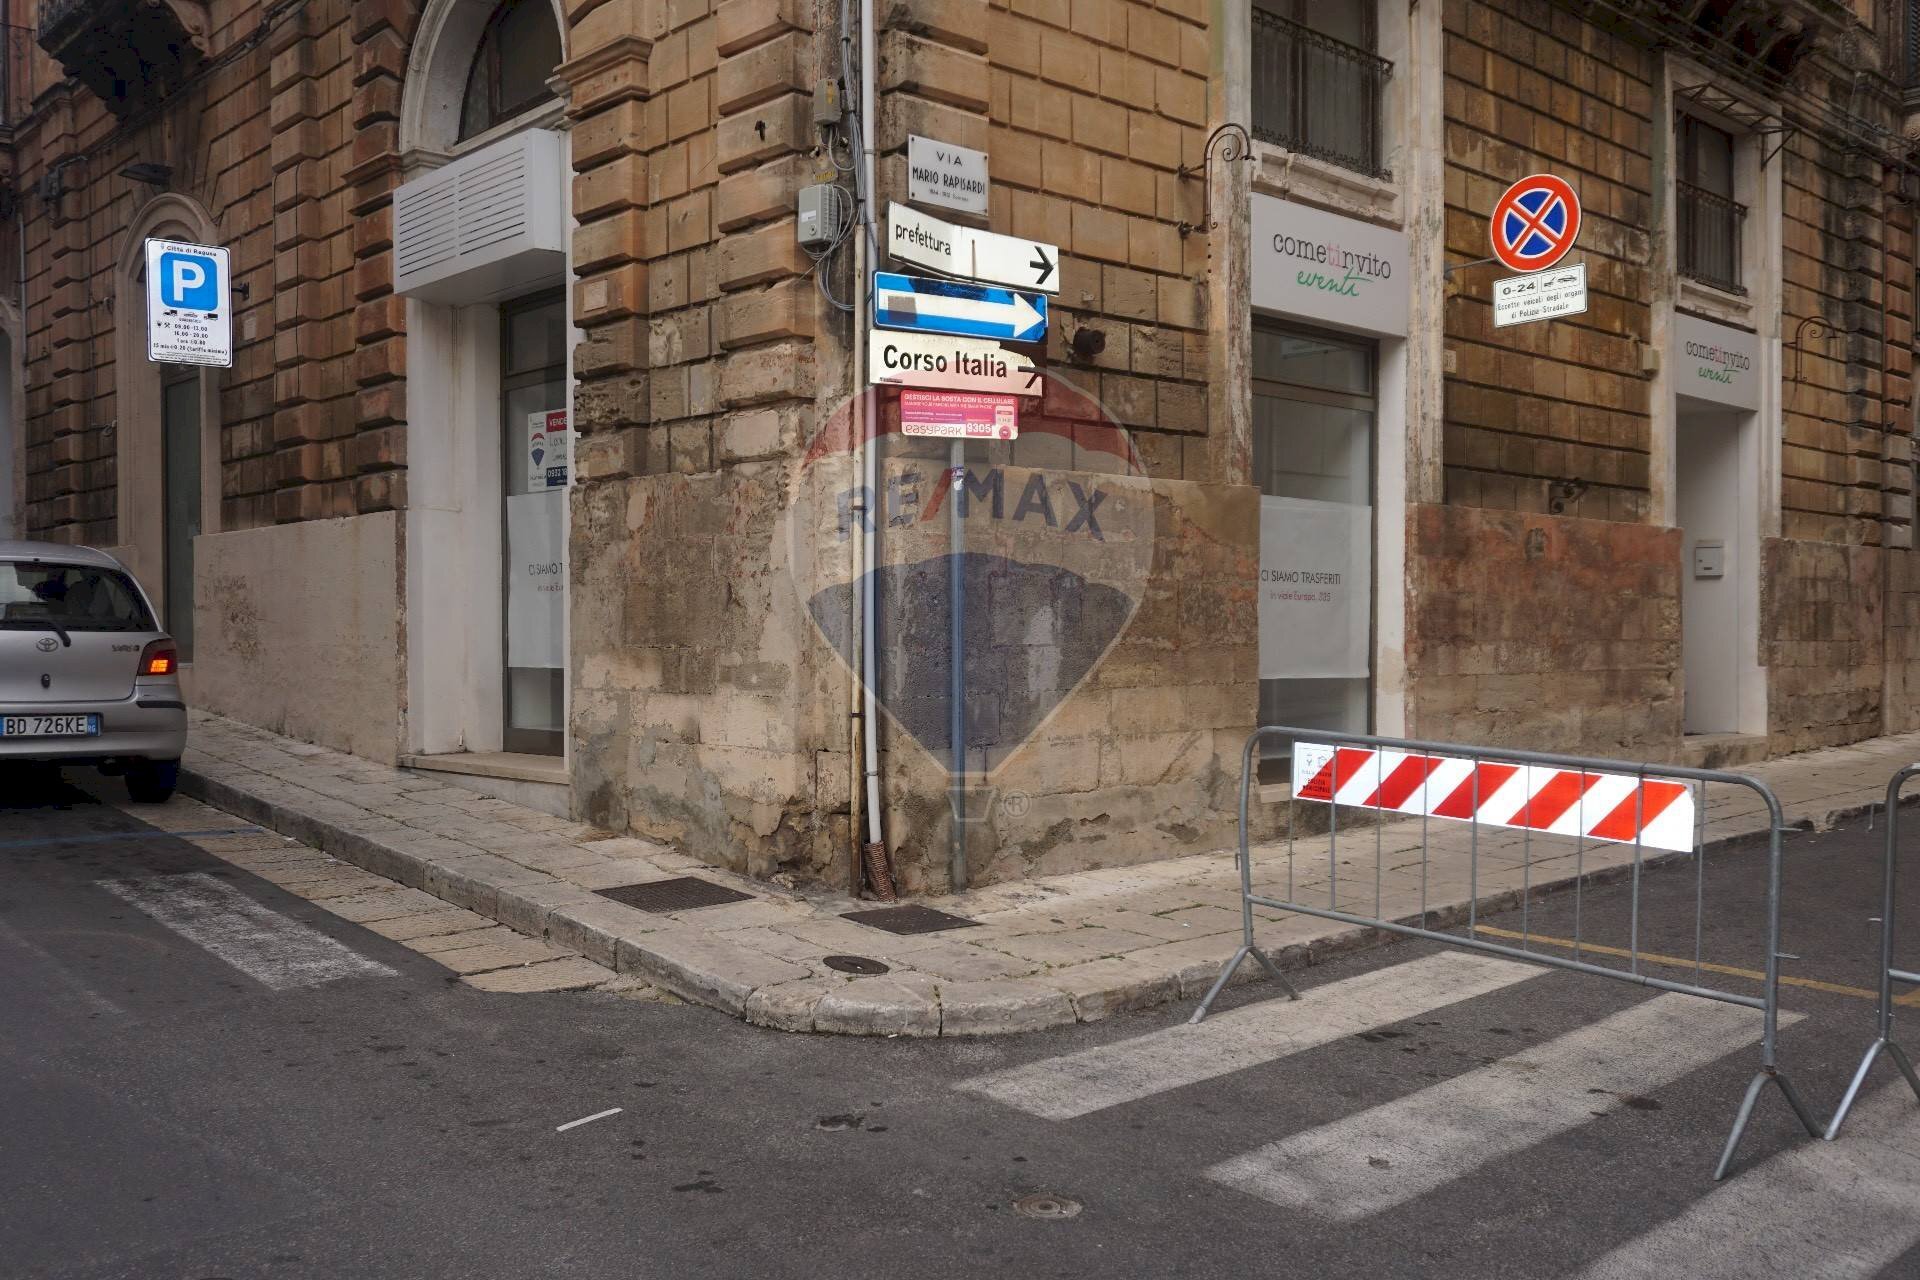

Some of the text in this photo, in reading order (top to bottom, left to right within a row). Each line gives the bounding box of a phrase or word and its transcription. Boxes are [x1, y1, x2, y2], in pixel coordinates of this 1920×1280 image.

[936, 151, 963, 167] VIA
[912, 166, 985, 195] MARIO RAPISARDI
[895, 223, 952, 256] prefettura
[193, 248, 217, 257] Ragusa
[1273, 233, 1391, 279] cometinvito
[173, 259, 206, 302] P
[1297, 266, 1374, 296] eventi
[1503, 282, 1536, 295] 0-24
[1519, 308, 1540, 318] Polizia
[1542, 302, 1569, 313] Stradale
[883, 344, 1007, 378] Corso Italia
[941, 395, 961, 403] SOSTA
[1271, 570, 1299, 583] SIAMO
[1301, 571, 1341, 585] TRASFERITI
[6, 718, 27, 735] BD
[33, 717, 86, 734] 726KE
